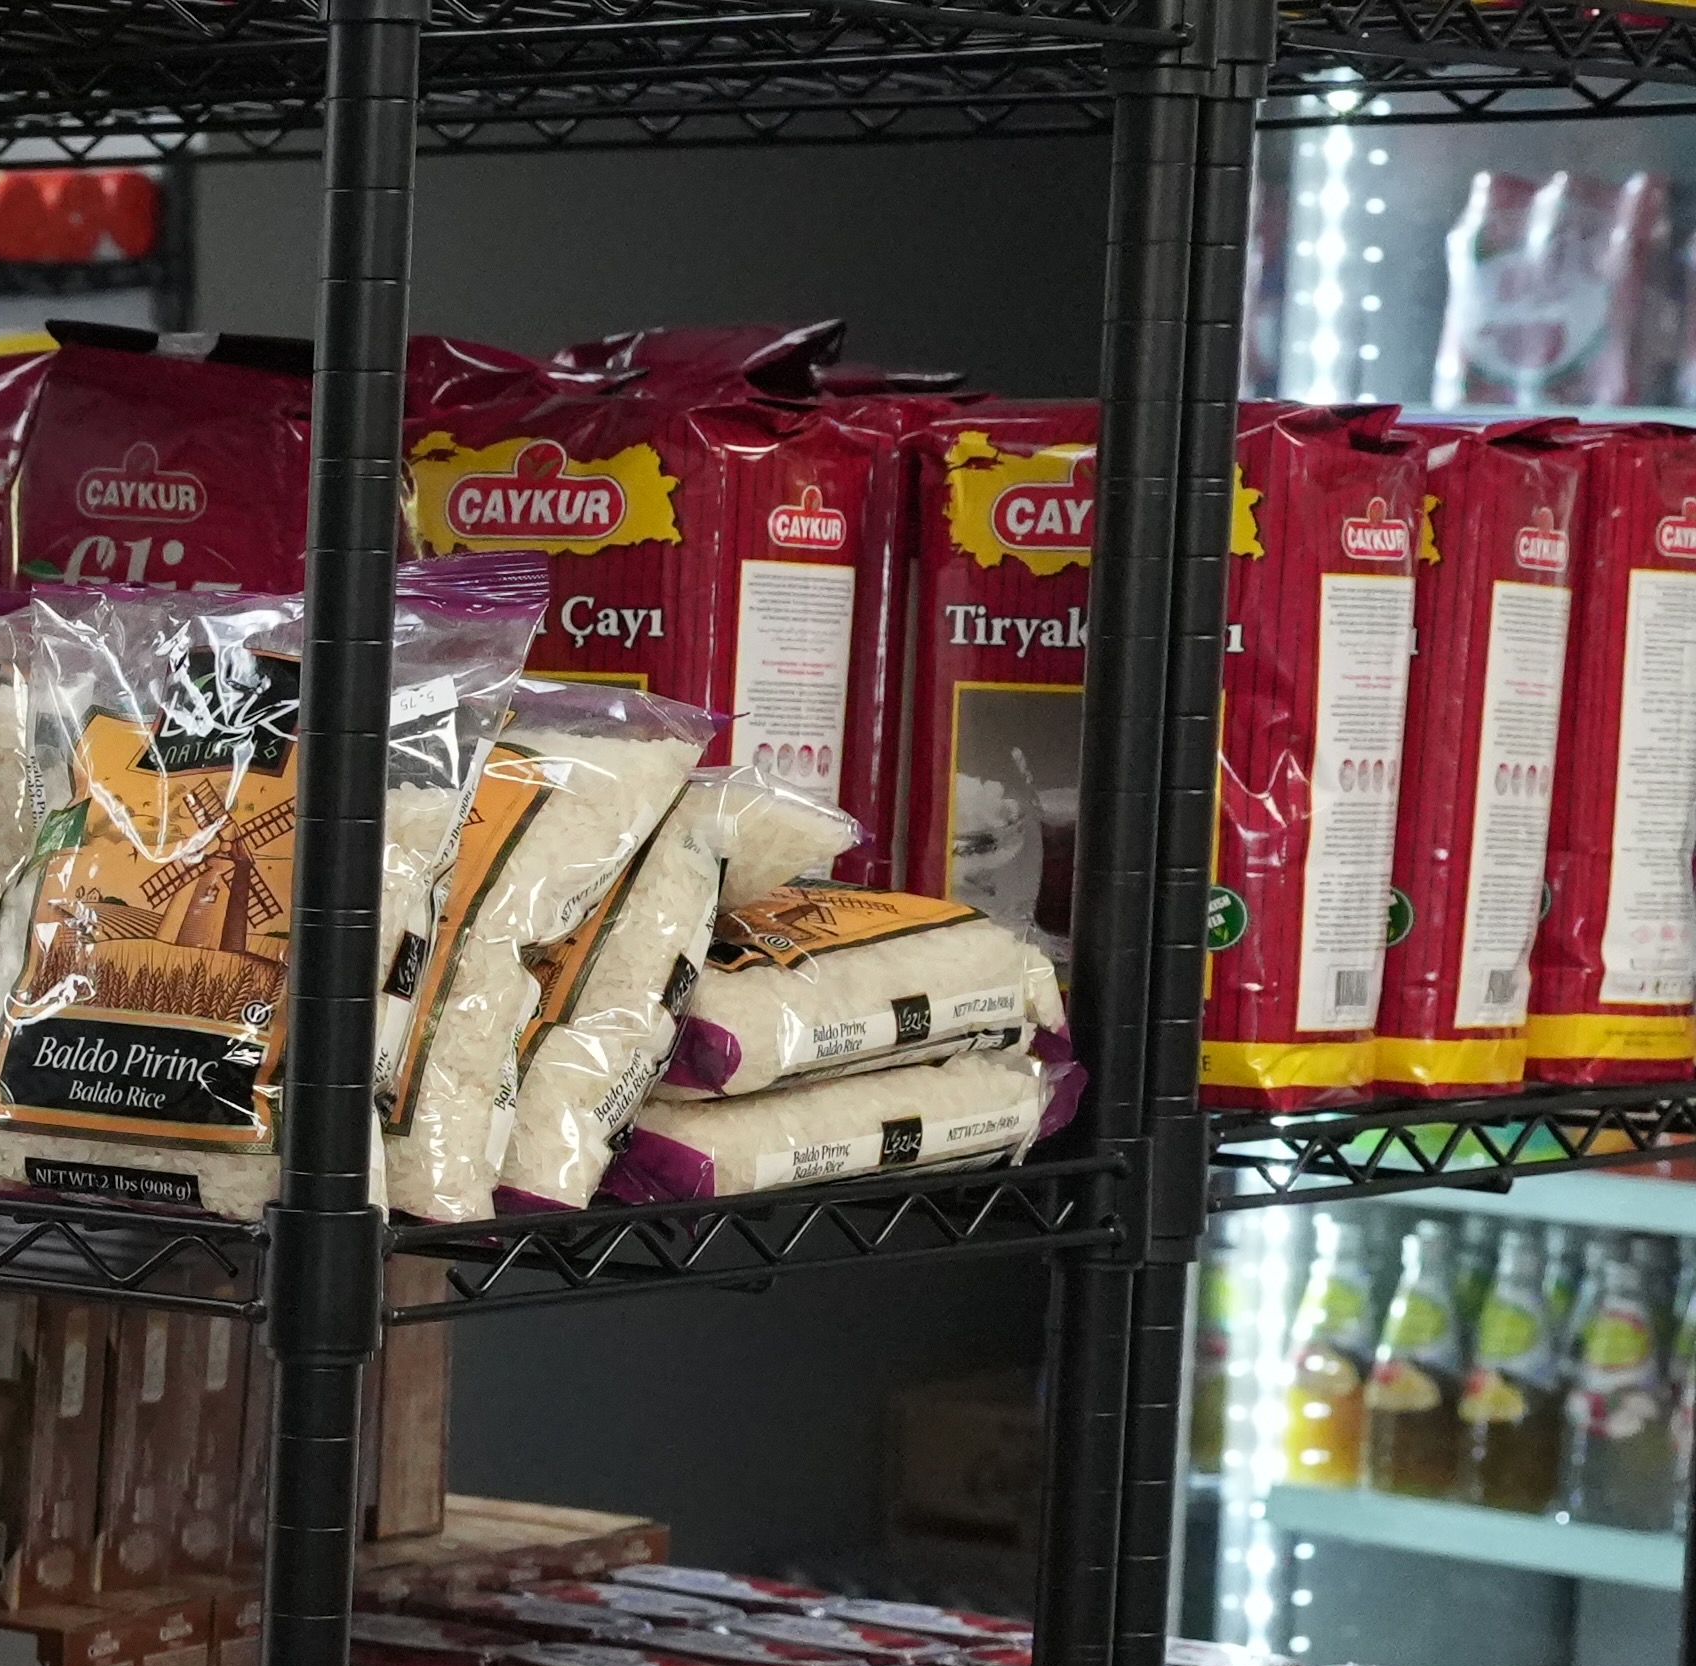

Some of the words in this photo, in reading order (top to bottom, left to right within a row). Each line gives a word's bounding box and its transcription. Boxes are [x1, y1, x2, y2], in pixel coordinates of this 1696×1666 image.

[86, 477, 197, 513] ÇAYKUR
[460, 483, 608, 529] ÇAYKUR
[777, 510, 843, 545] ÇAYKUR
[1347, 525, 1407, 552] ÇAYKUR
[561, 597, 664, 646] Çayı
[946, 604, 1090, 656] Tiryak
[813, 1026, 839, 1043] Baldo
[840, 1020, 867, 1038] Pirinç
[816, 1042, 844, 1059] Baldo
[845, 1037, 864, 1051] Rice
[33, 1036, 120, 1074] Baldo
[69, 1080, 124, 1107] Baldo
[125, 1085, 166, 1110] Rice
[593, 1084, 626, 1124] Baldo
[606, 1095, 635, 1129] Baldo
[793, 1147, 820, 1166] Baldo
[821, 1142, 852, 1158] Pirinç
[793, 1163, 822, 1181] Baldo
[823, 1159, 845, 1174] Rice
[35, 1168, 68, 1185] NET
[114, 1174, 139, 1193] lbs
[140, 1178, 173, 1198] (908
[175, 1182, 193, 1202] g)
